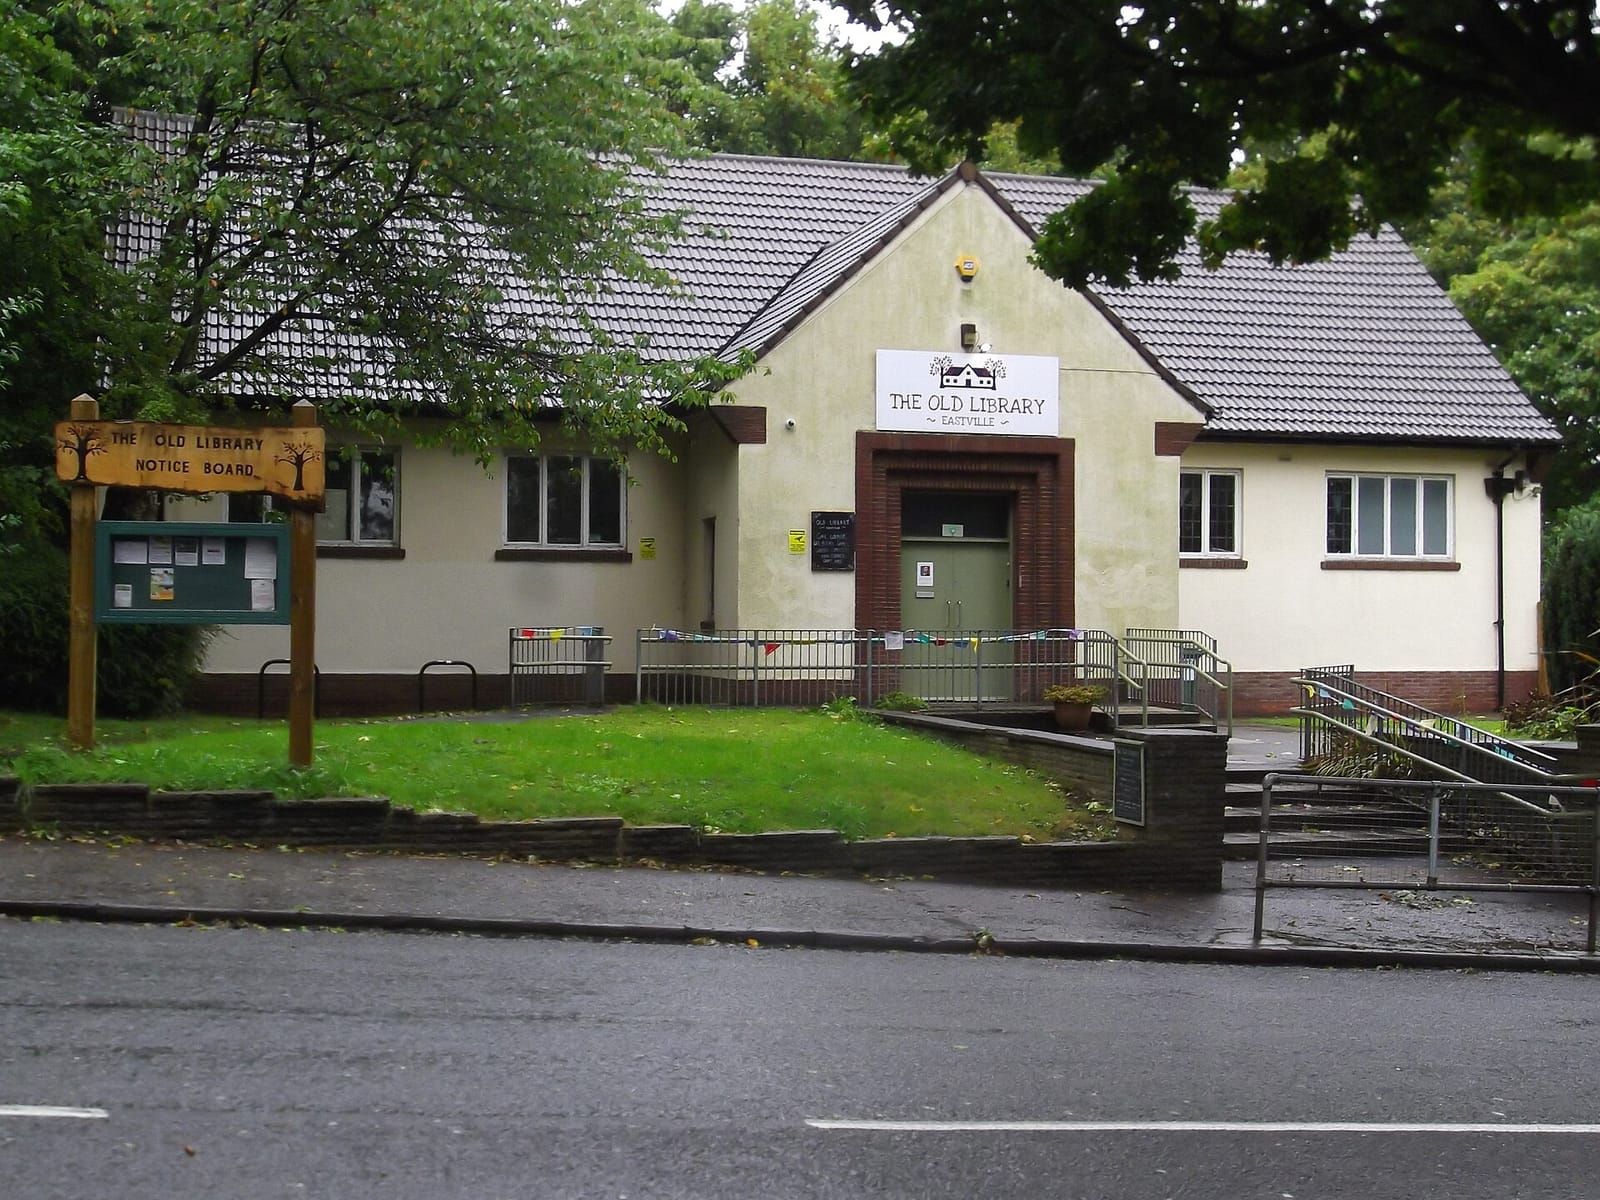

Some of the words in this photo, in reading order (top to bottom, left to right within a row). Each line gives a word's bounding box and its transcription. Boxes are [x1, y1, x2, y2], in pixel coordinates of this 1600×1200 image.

[890, 393, 922, 410] THE
[928, 395, 963, 412] OLD
[970, 396, 1045, 415] LIBRARY
[941, 416, 995, 427] EASTVILLE
[111, 431, 137, 445] THE
[155, 434, 186, 448] OLD
[196, 436, 264, 451] LIBRARY
[136, 459, 190, 473] NOTICE
[204, 462, 254, 476] BOARD
